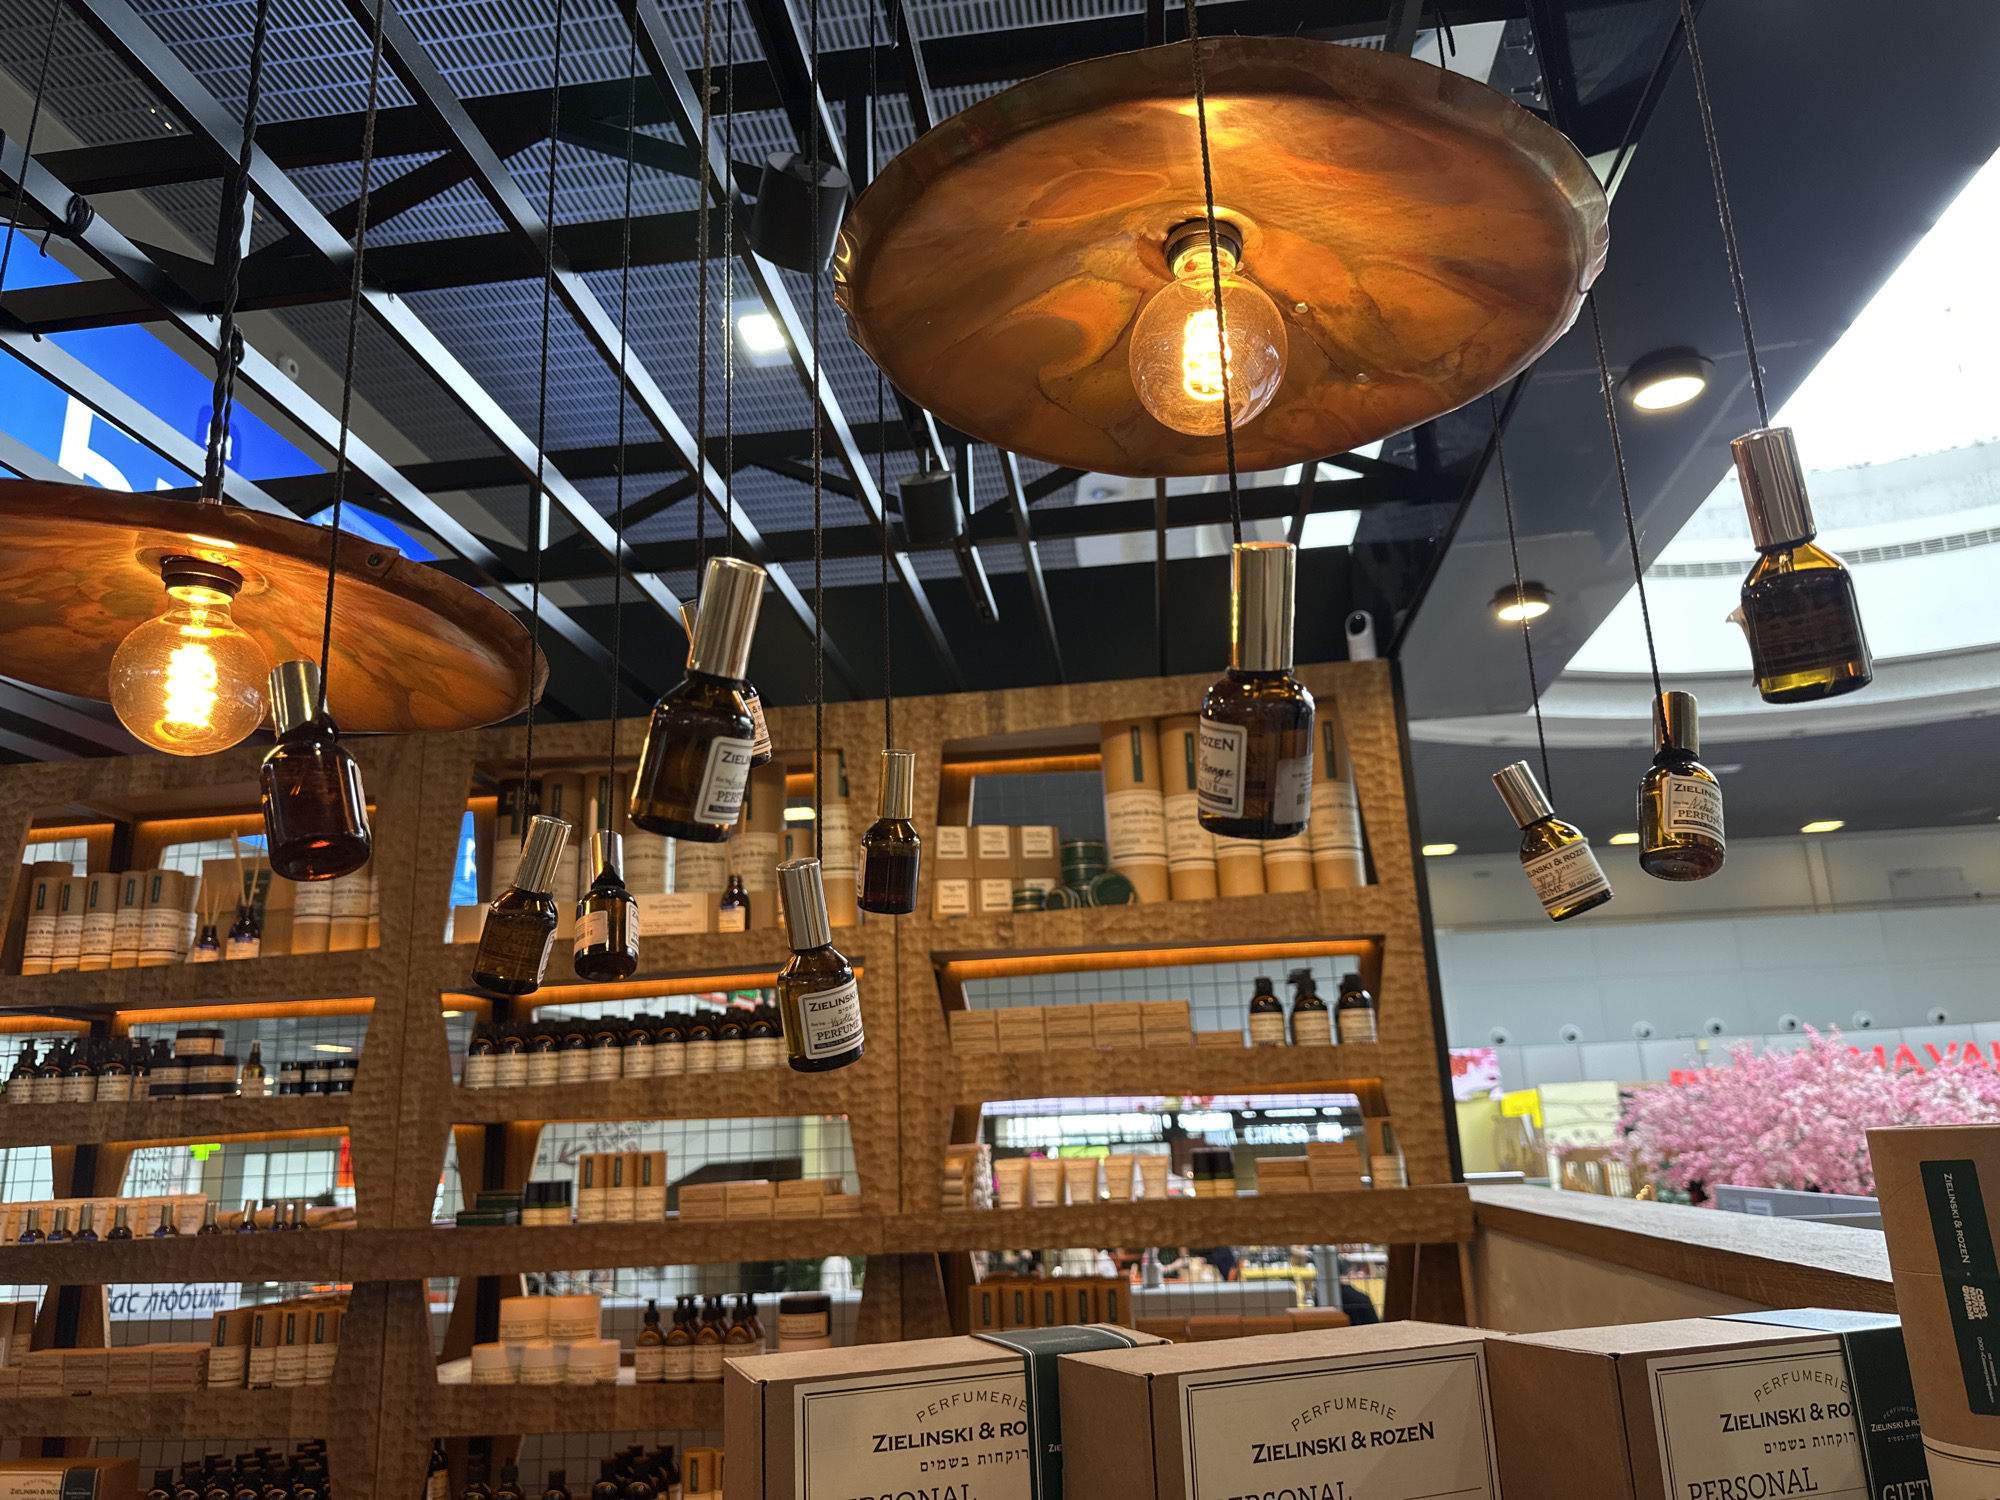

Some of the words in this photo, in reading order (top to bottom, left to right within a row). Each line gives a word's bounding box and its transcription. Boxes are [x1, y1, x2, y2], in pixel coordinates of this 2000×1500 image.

[1553, 858, 1562, 866] &
[1563, 846, 1588, 862] ROZEN
[817, 1020, 859, 1041] PERFUME
[1943, 1173, 1959, 1219] ZIELINSKI
[1954, 1220, 1962, 1228] &
[1956, 1229, 1970, 1264] ROZEN
[1962, 1285, 1975, 1320] ФИЛЬМ
[1968, 1286, 1982, 1320] МУЛЬТ
[1975, 1288, 1988, 1318] СОЮЗ
[1753, 1370, 1849, 1402] PERFUMERIE
[915, 1390, 1028, 1423] PERFUMERIE
[1291, 1397, 1396, 1432] PERFUMERIE
[1720, 1407, 1806, 1433] ZIELINSKI
[1810, 1403, 1824, 1421] &
[1827, 1402, 1854, 1419] RO
[872, 1426, 974, 1453] ZIELINSKI
[978, 1422, 995, 1439] &
[1812, 1431, 1857, 1448] רוקחות
[1871, 1422, 1903, 1432] ZIELINSKI
[1904, 1419, 1910, 1427] &
[977, 1449, 1029, 1465] רוקחות
[1252, 1435, 1347, 1464] ZIELINSKI
[1351, 1431, 1366, 1449] &
[1370, 1421, 1435, 1447] ROZEN
[1764, 1438, 1806, 1454] בשמים
[920, 1456, 970, 1472] בשמים
[1688, 1466, 1819, 1500] PERSONAL
[1883, 1479, 1929, 1500] GIFT
